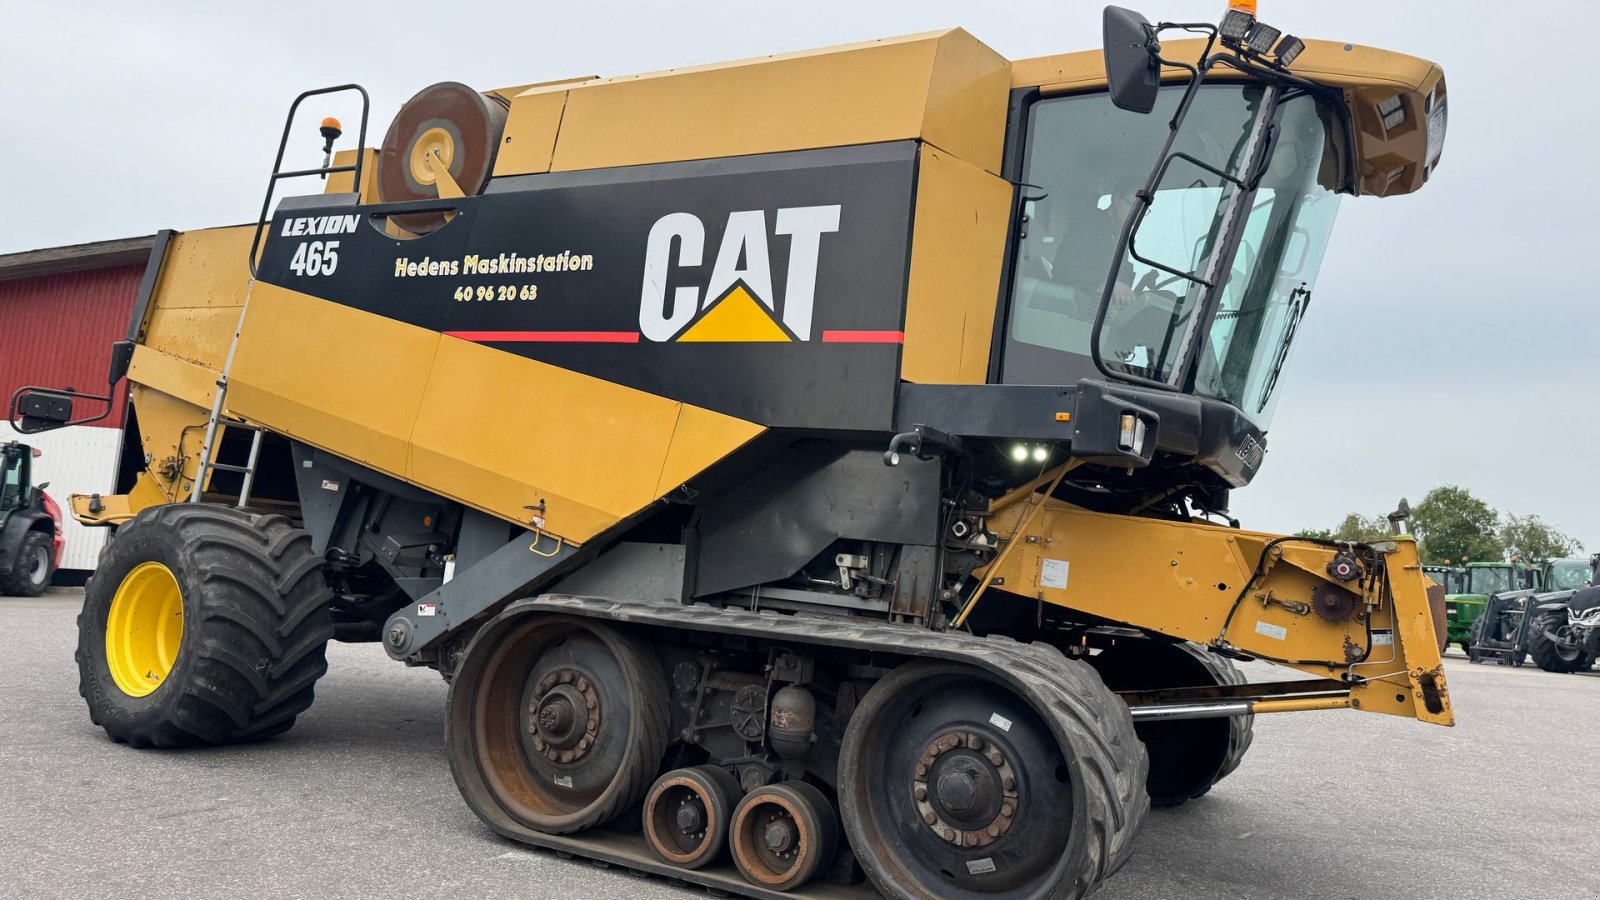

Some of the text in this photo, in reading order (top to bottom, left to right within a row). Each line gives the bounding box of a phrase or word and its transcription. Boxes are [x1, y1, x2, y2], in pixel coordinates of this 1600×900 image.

[281, 214, 361, 237] LEXION
[290, 241, 340, 276] 465
[394, 250, 594, 277] Hedens Maskinstation
[639, 204, 842, 342] CAT
[454, 285, 538, 302] 40 96 20 63
